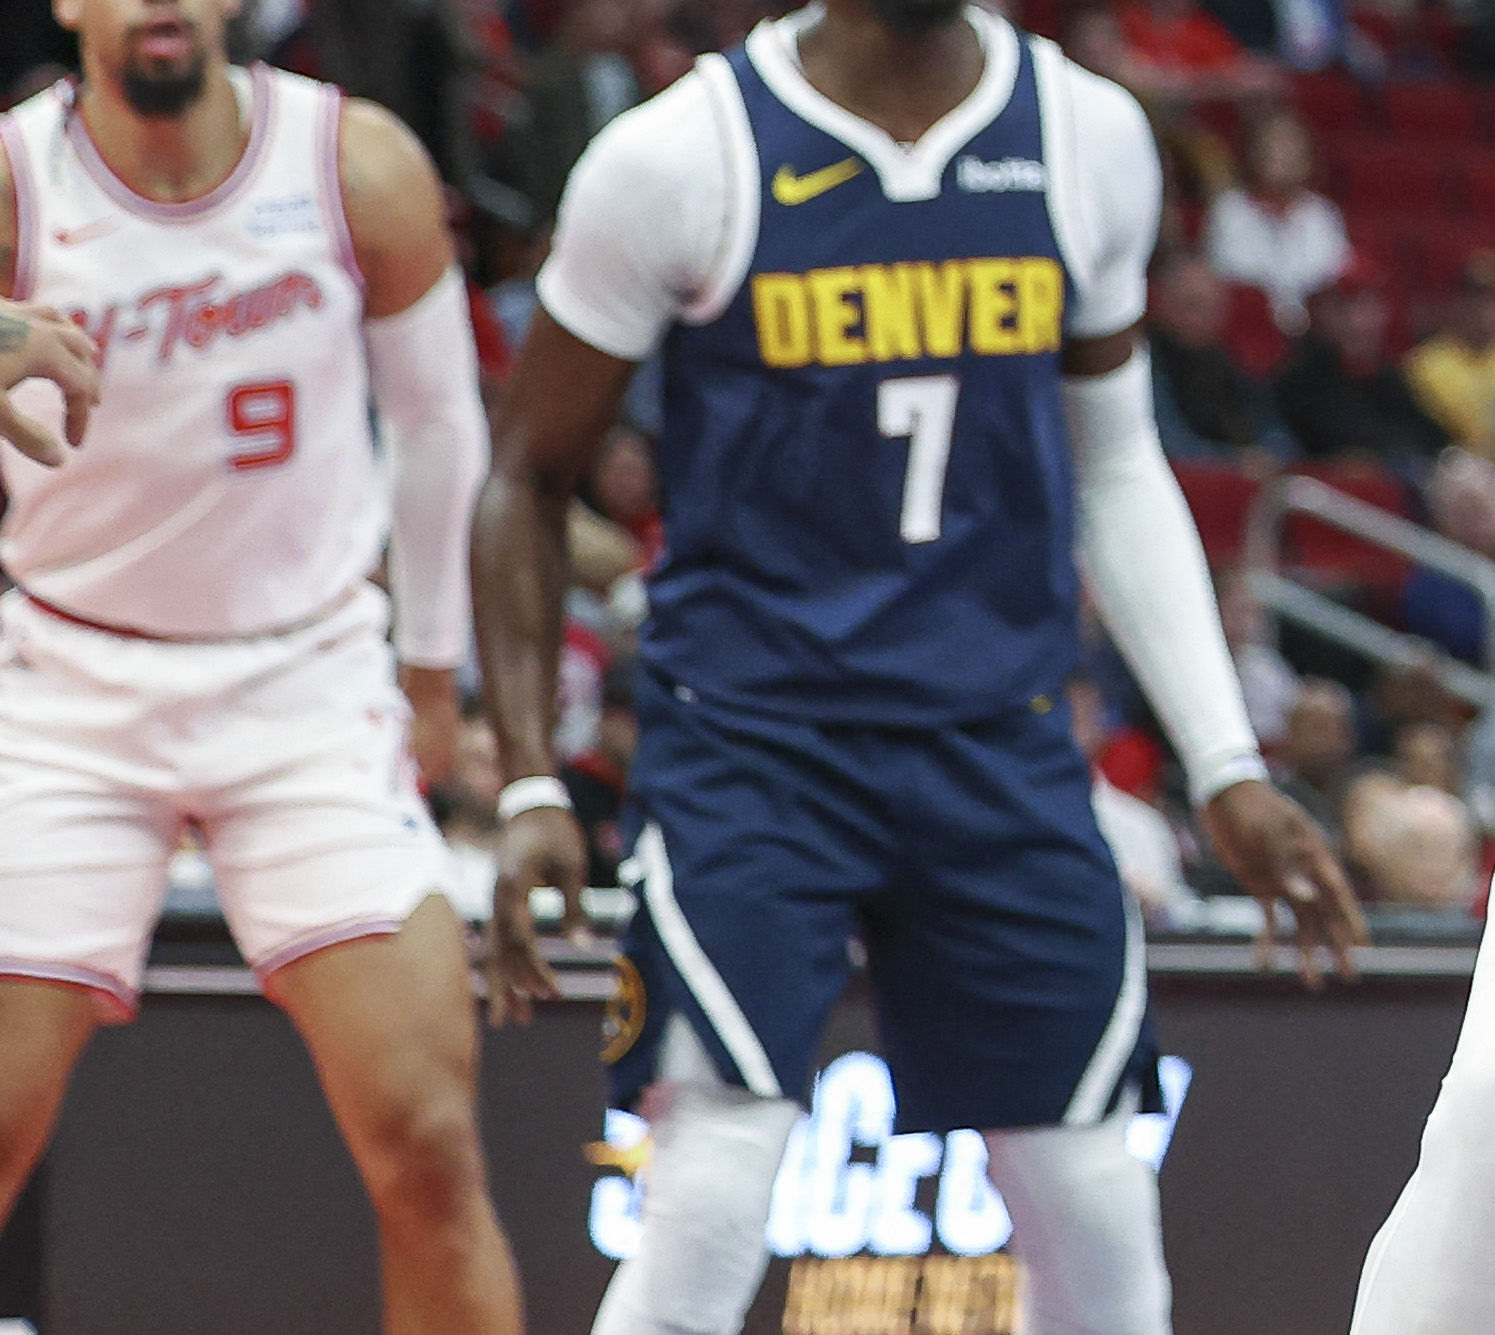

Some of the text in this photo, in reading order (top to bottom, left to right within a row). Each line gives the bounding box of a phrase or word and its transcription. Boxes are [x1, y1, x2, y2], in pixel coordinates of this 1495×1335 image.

[751, 256, 1066, 368] DENVER
[228, 378, 295, 472] 9
[875, 373, 963, 545] 7
